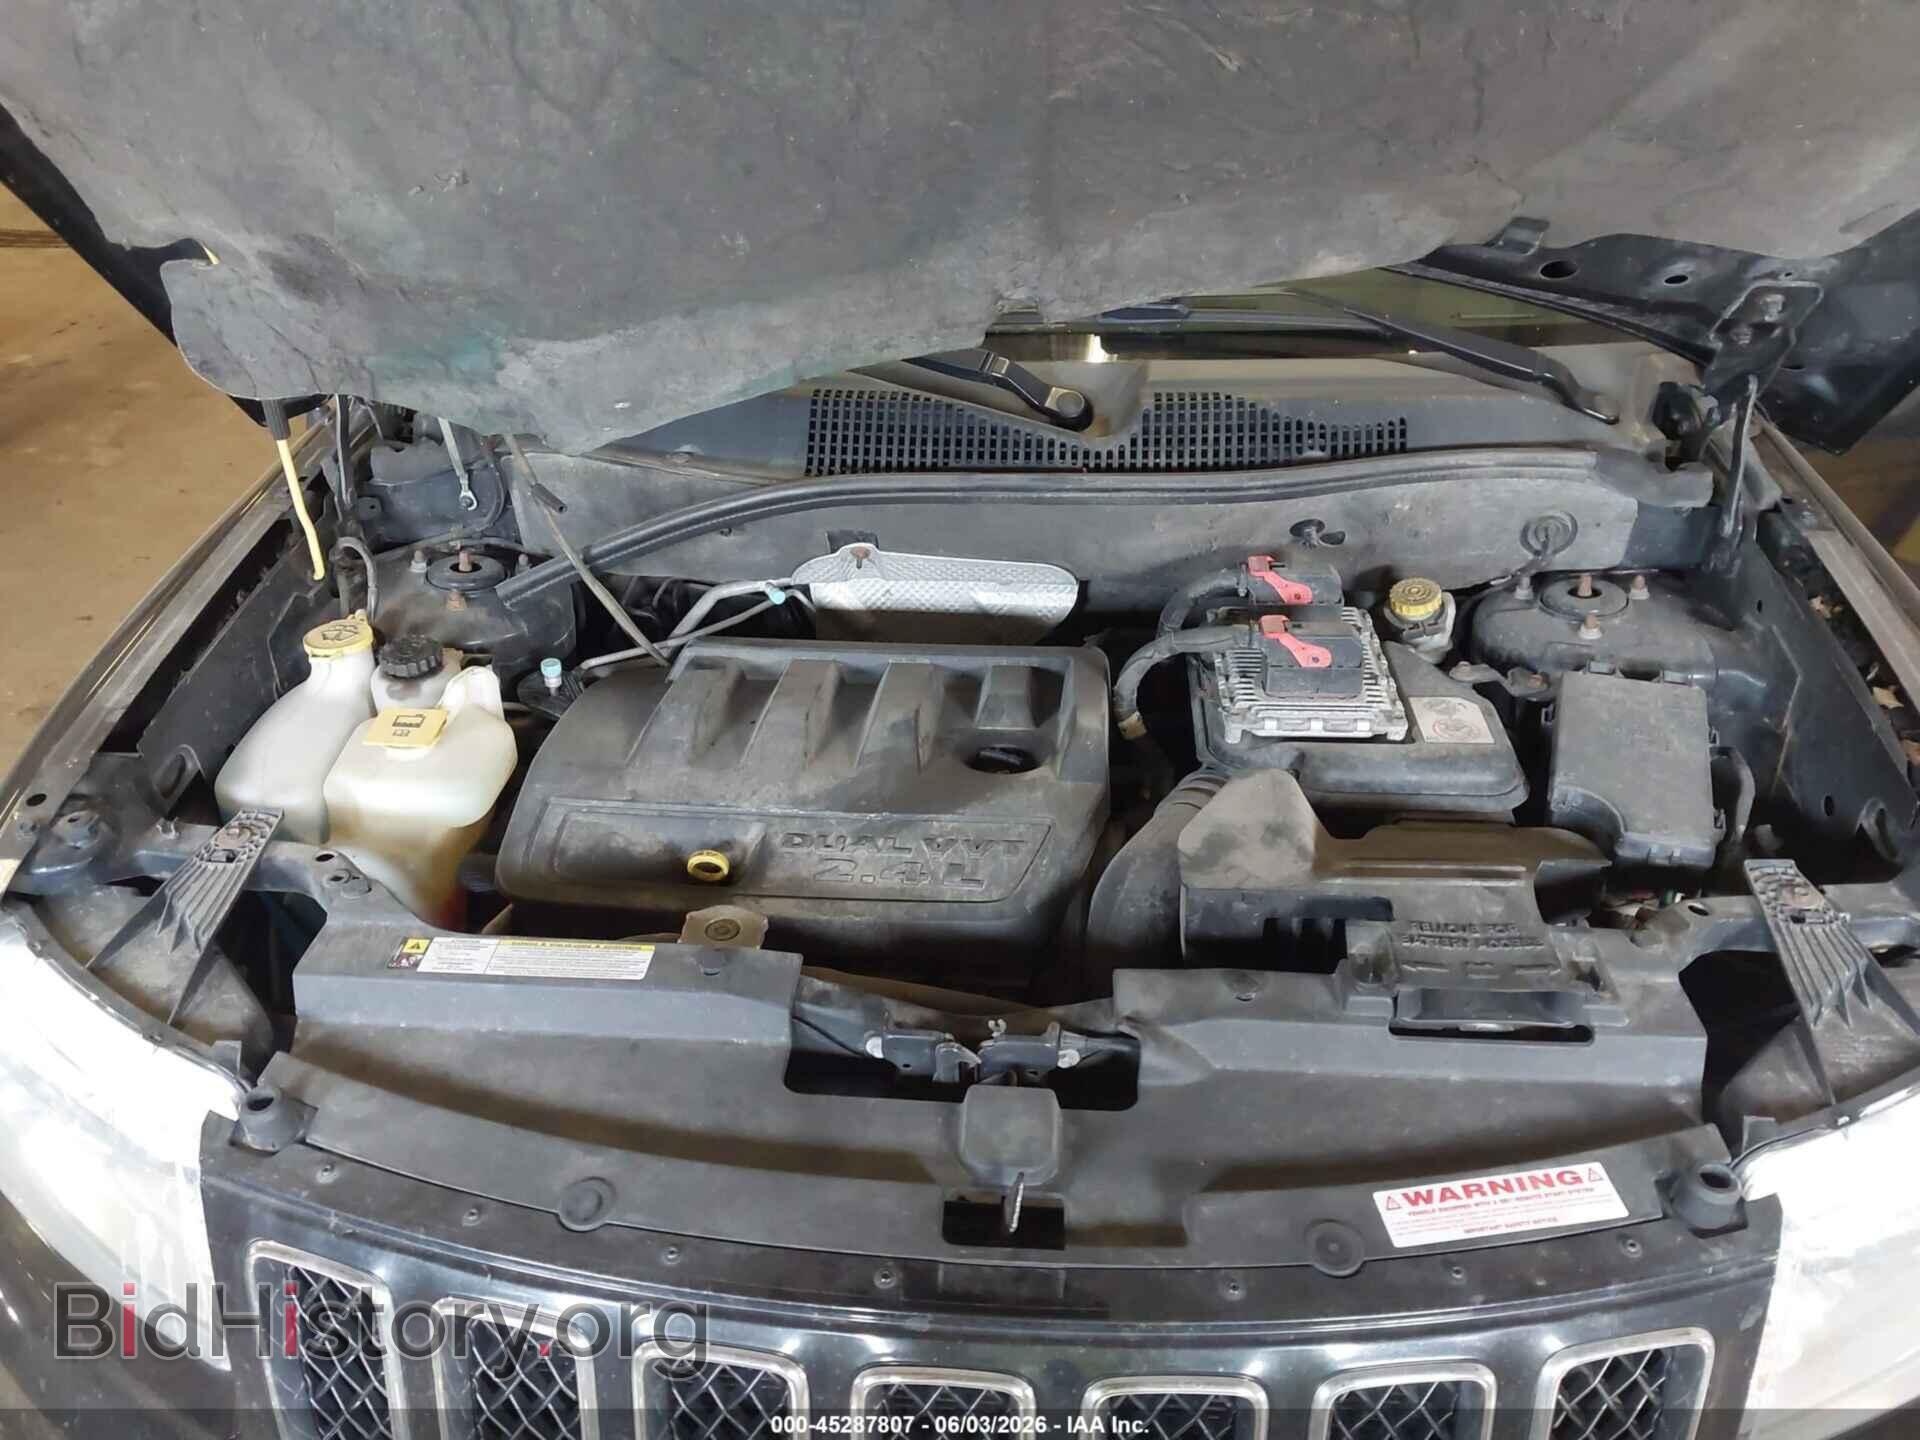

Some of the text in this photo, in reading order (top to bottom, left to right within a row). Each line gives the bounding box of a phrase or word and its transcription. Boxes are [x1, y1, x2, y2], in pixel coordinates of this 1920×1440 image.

[780, 832, 913, 857] DUAL
[813, 857, 986, 888] 2.4L
[1401, 1170, 1585, 1207] WARNING
